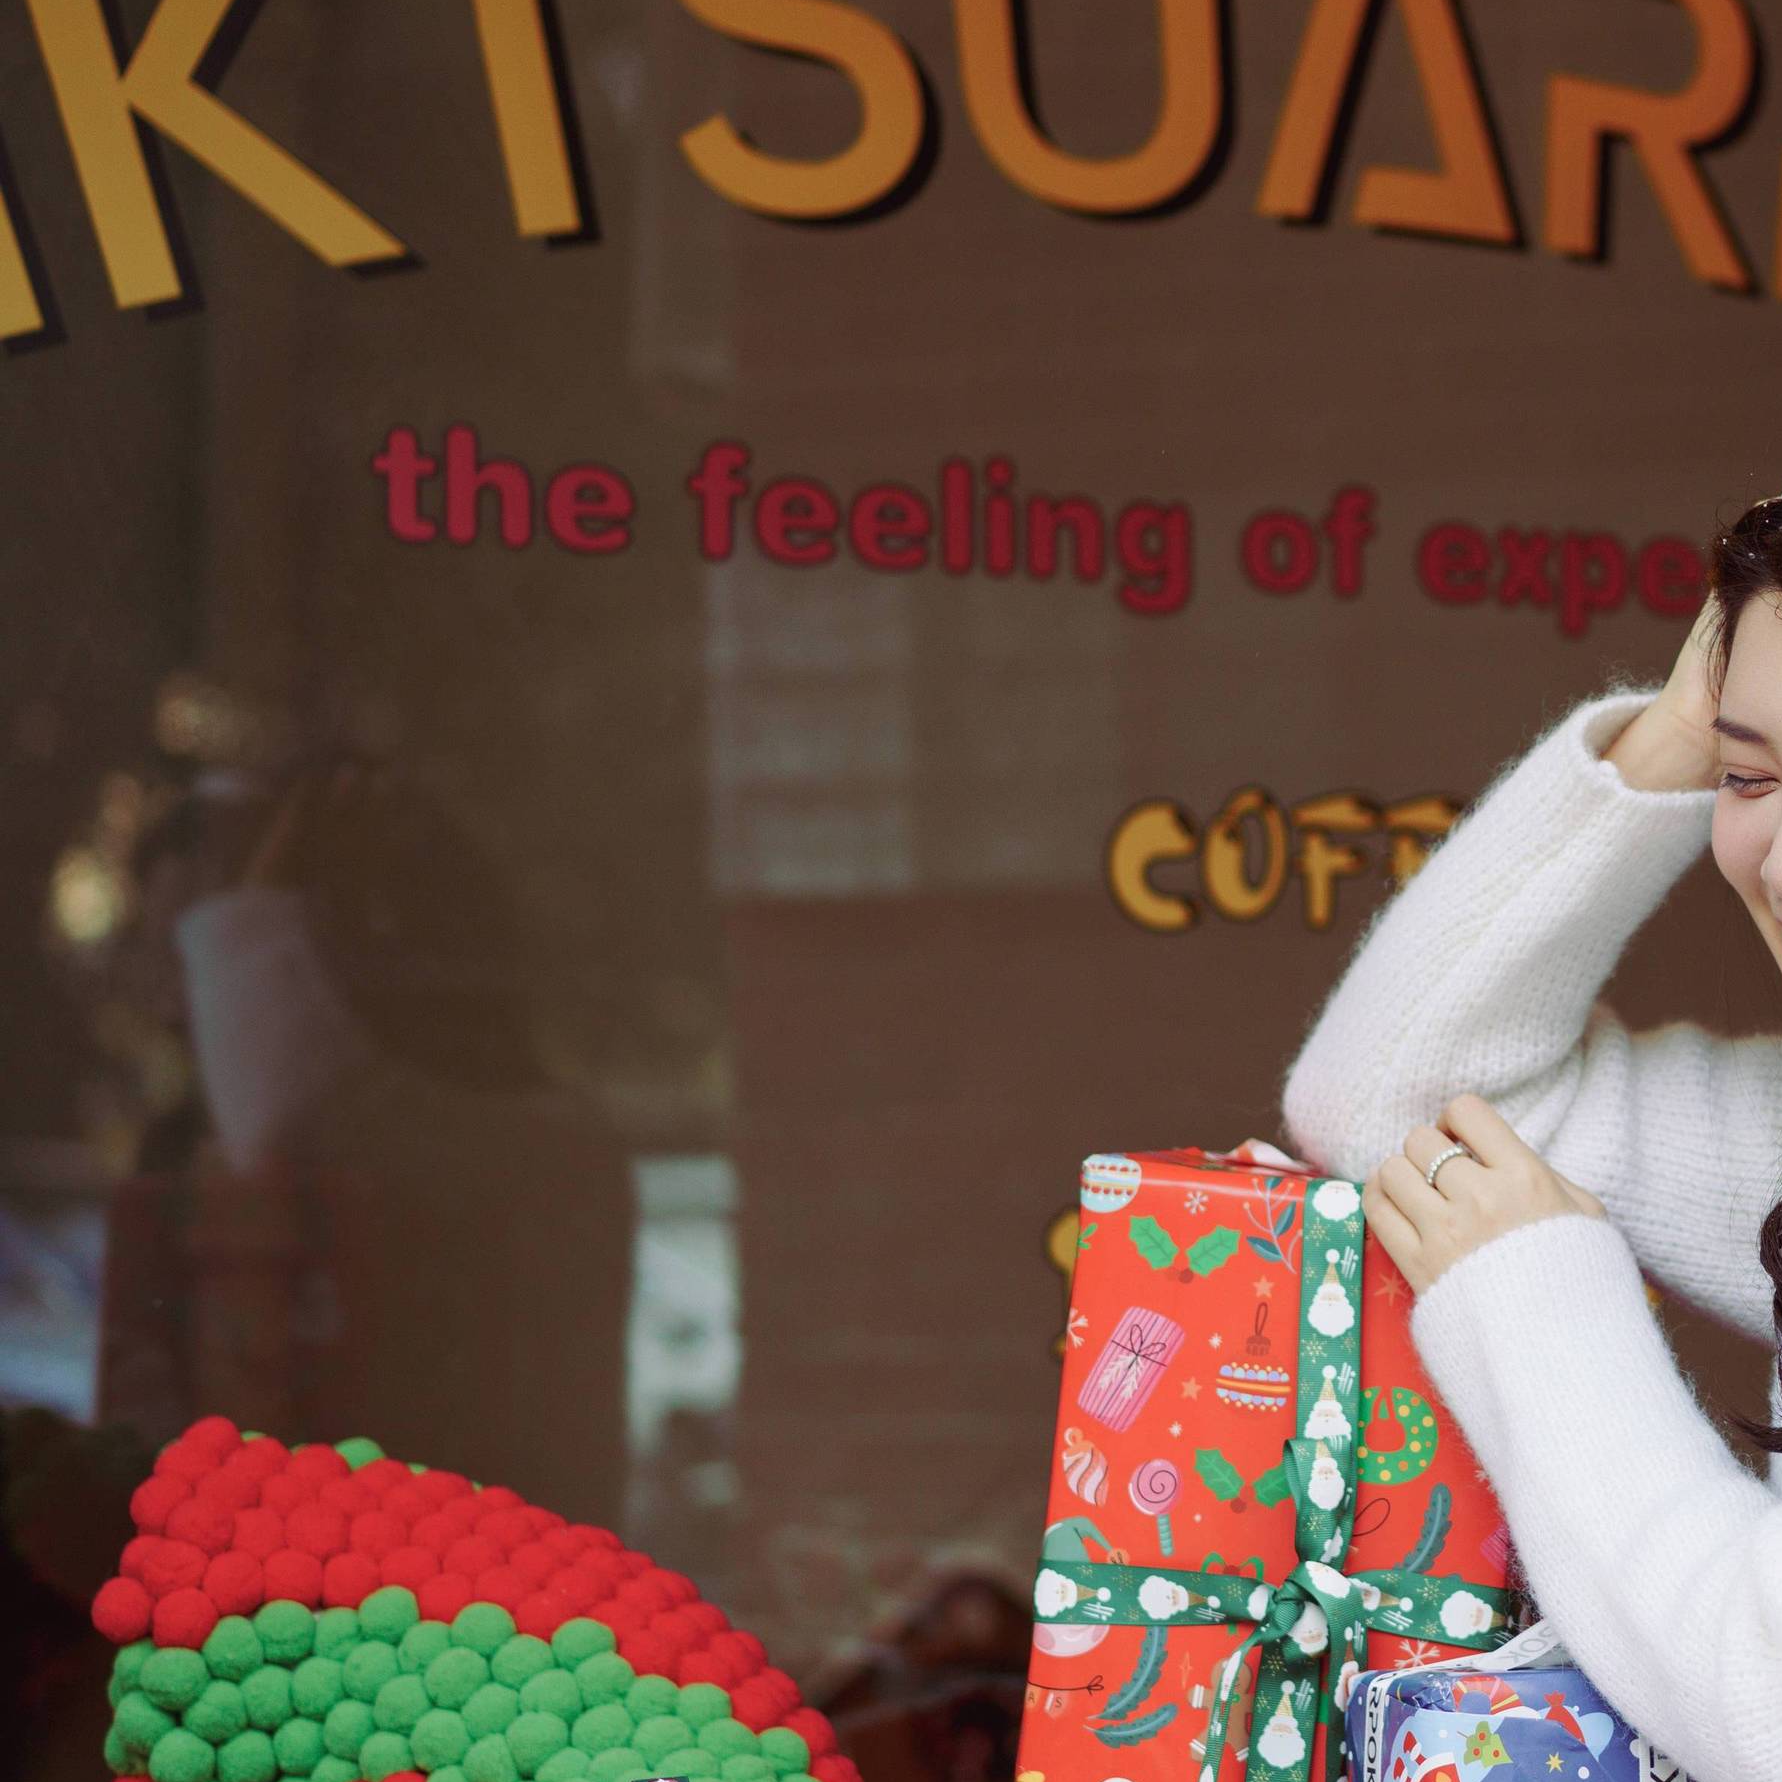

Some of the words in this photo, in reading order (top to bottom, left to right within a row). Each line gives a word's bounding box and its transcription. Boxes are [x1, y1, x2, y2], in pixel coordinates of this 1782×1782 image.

[370, 422, 636, 553] the
[686, 439, 1194, 616] feeling
[1240, 486, 1375, 597] of
